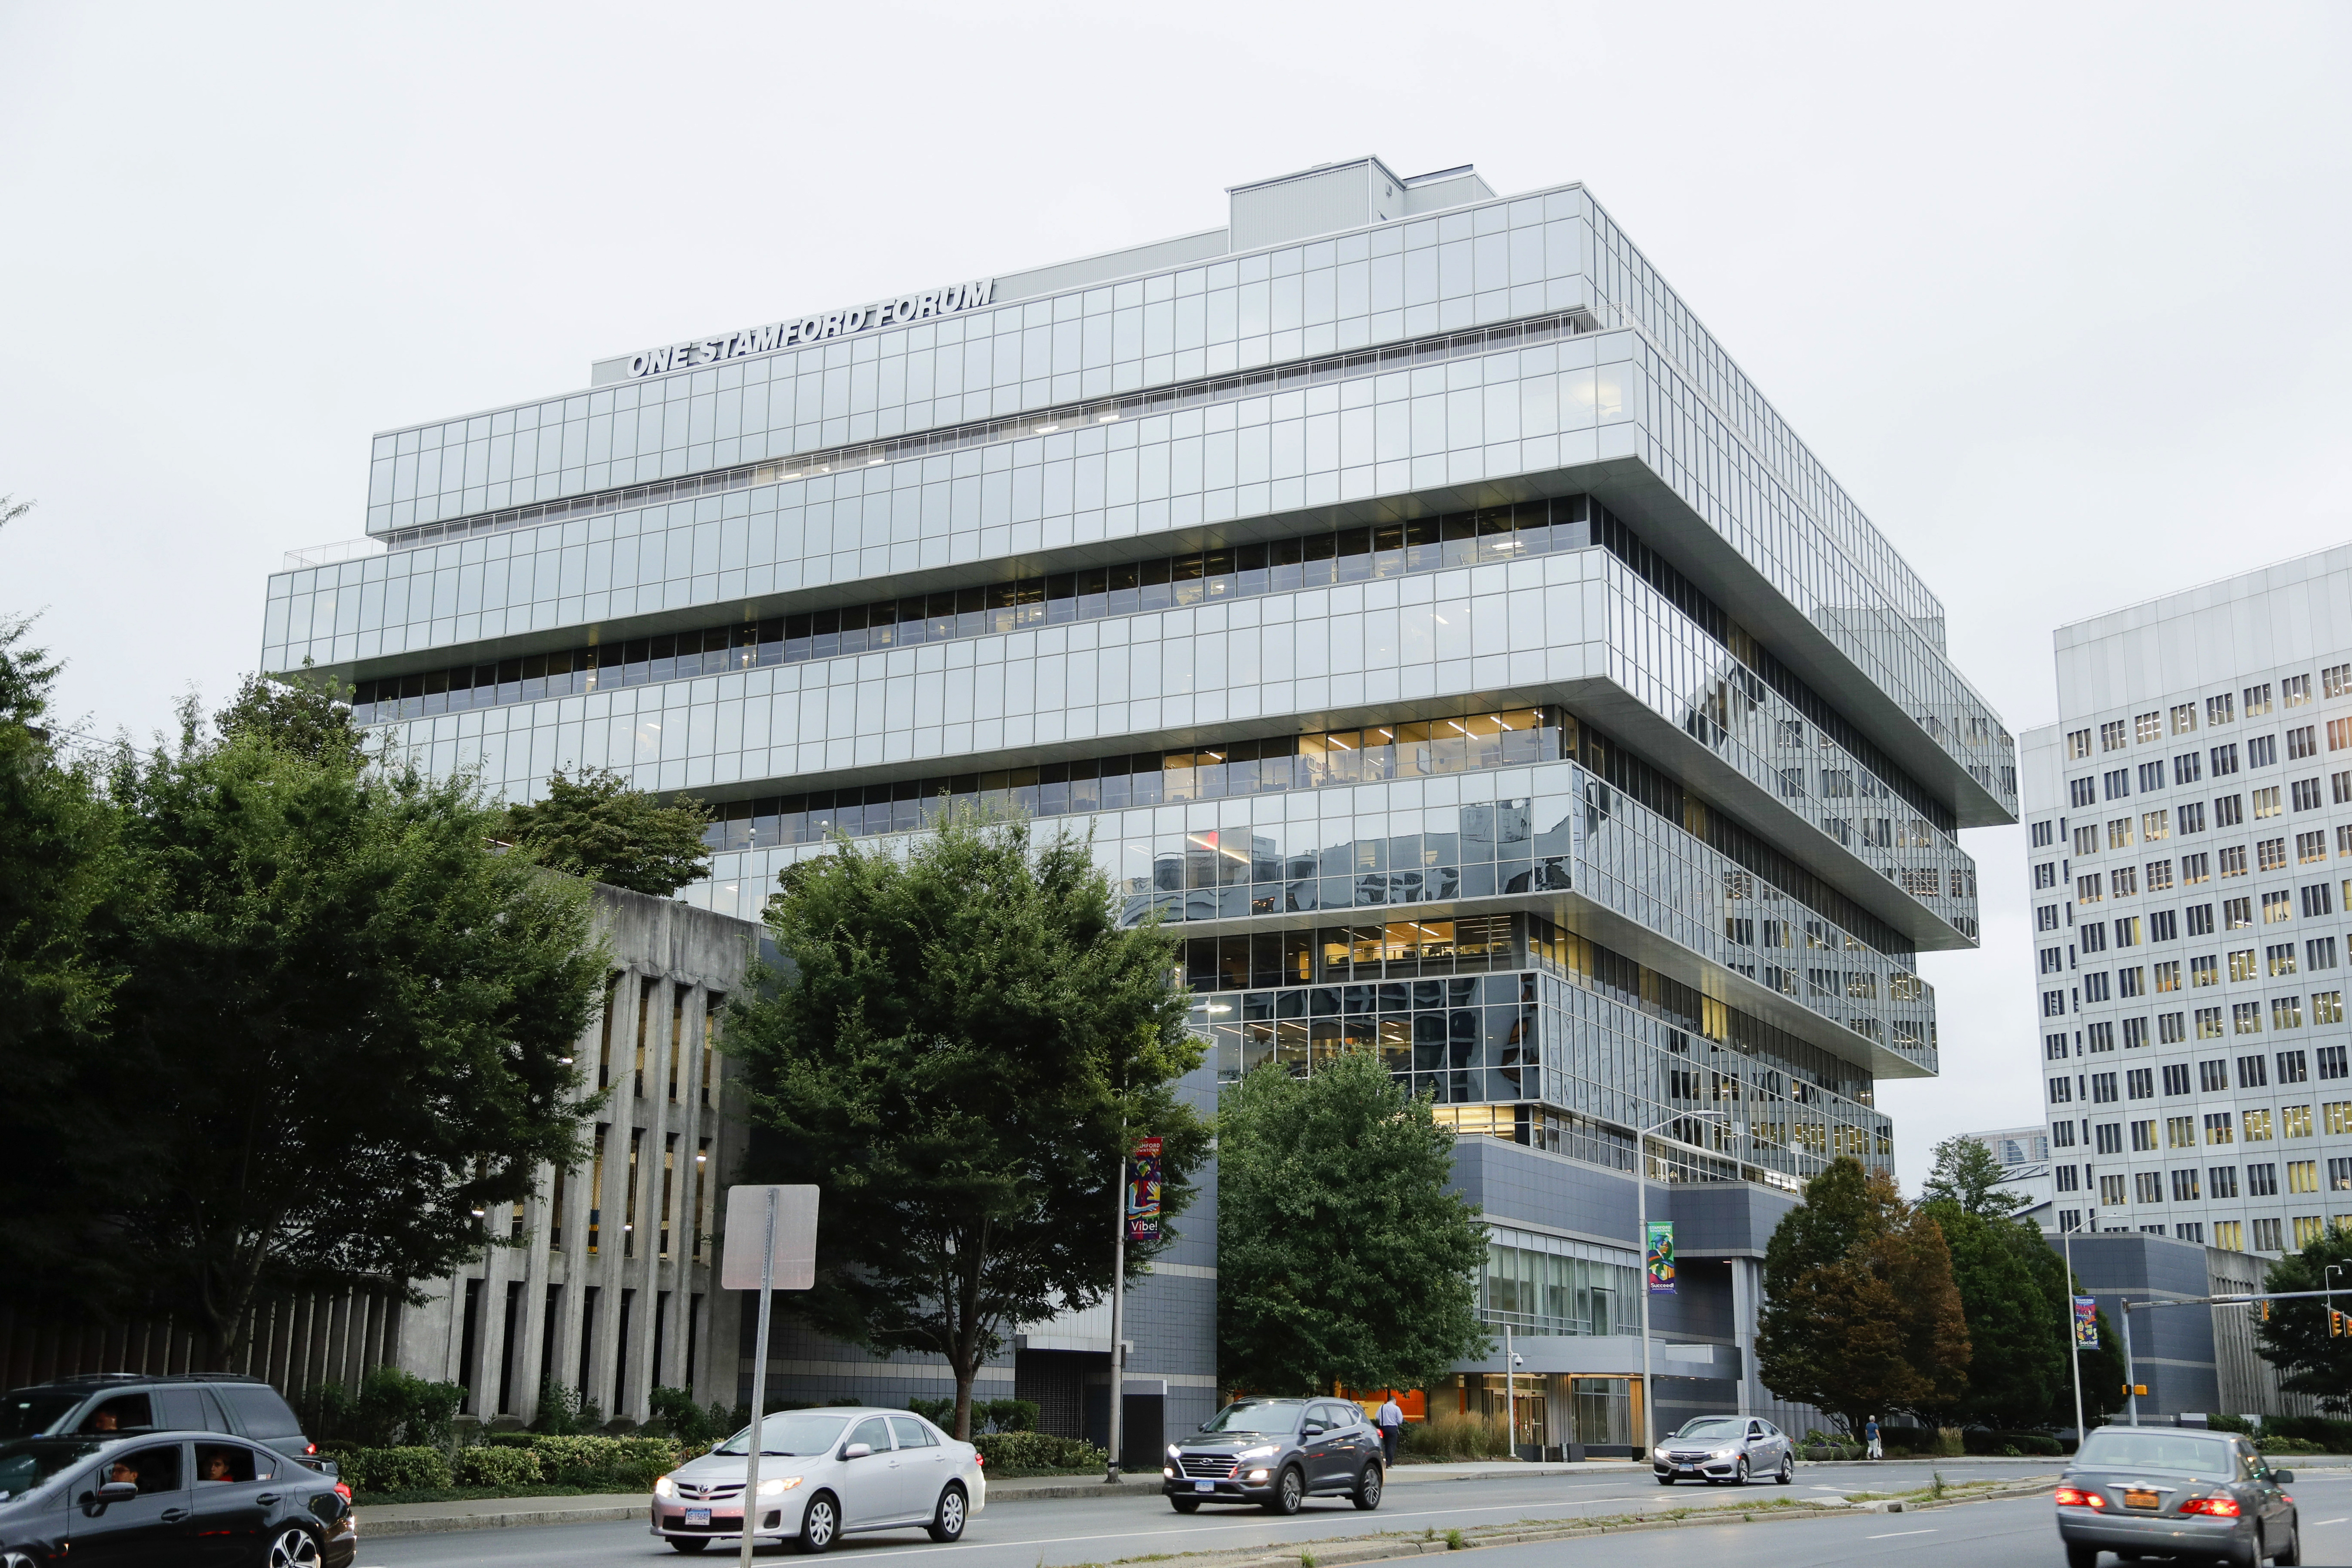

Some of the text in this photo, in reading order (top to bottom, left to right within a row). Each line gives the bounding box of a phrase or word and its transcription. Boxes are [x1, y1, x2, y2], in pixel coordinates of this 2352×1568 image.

[627, 277, 994, 378] ONE STAMFORD FORUM
[1131, 1220, 1157, 1231] Vibe!
